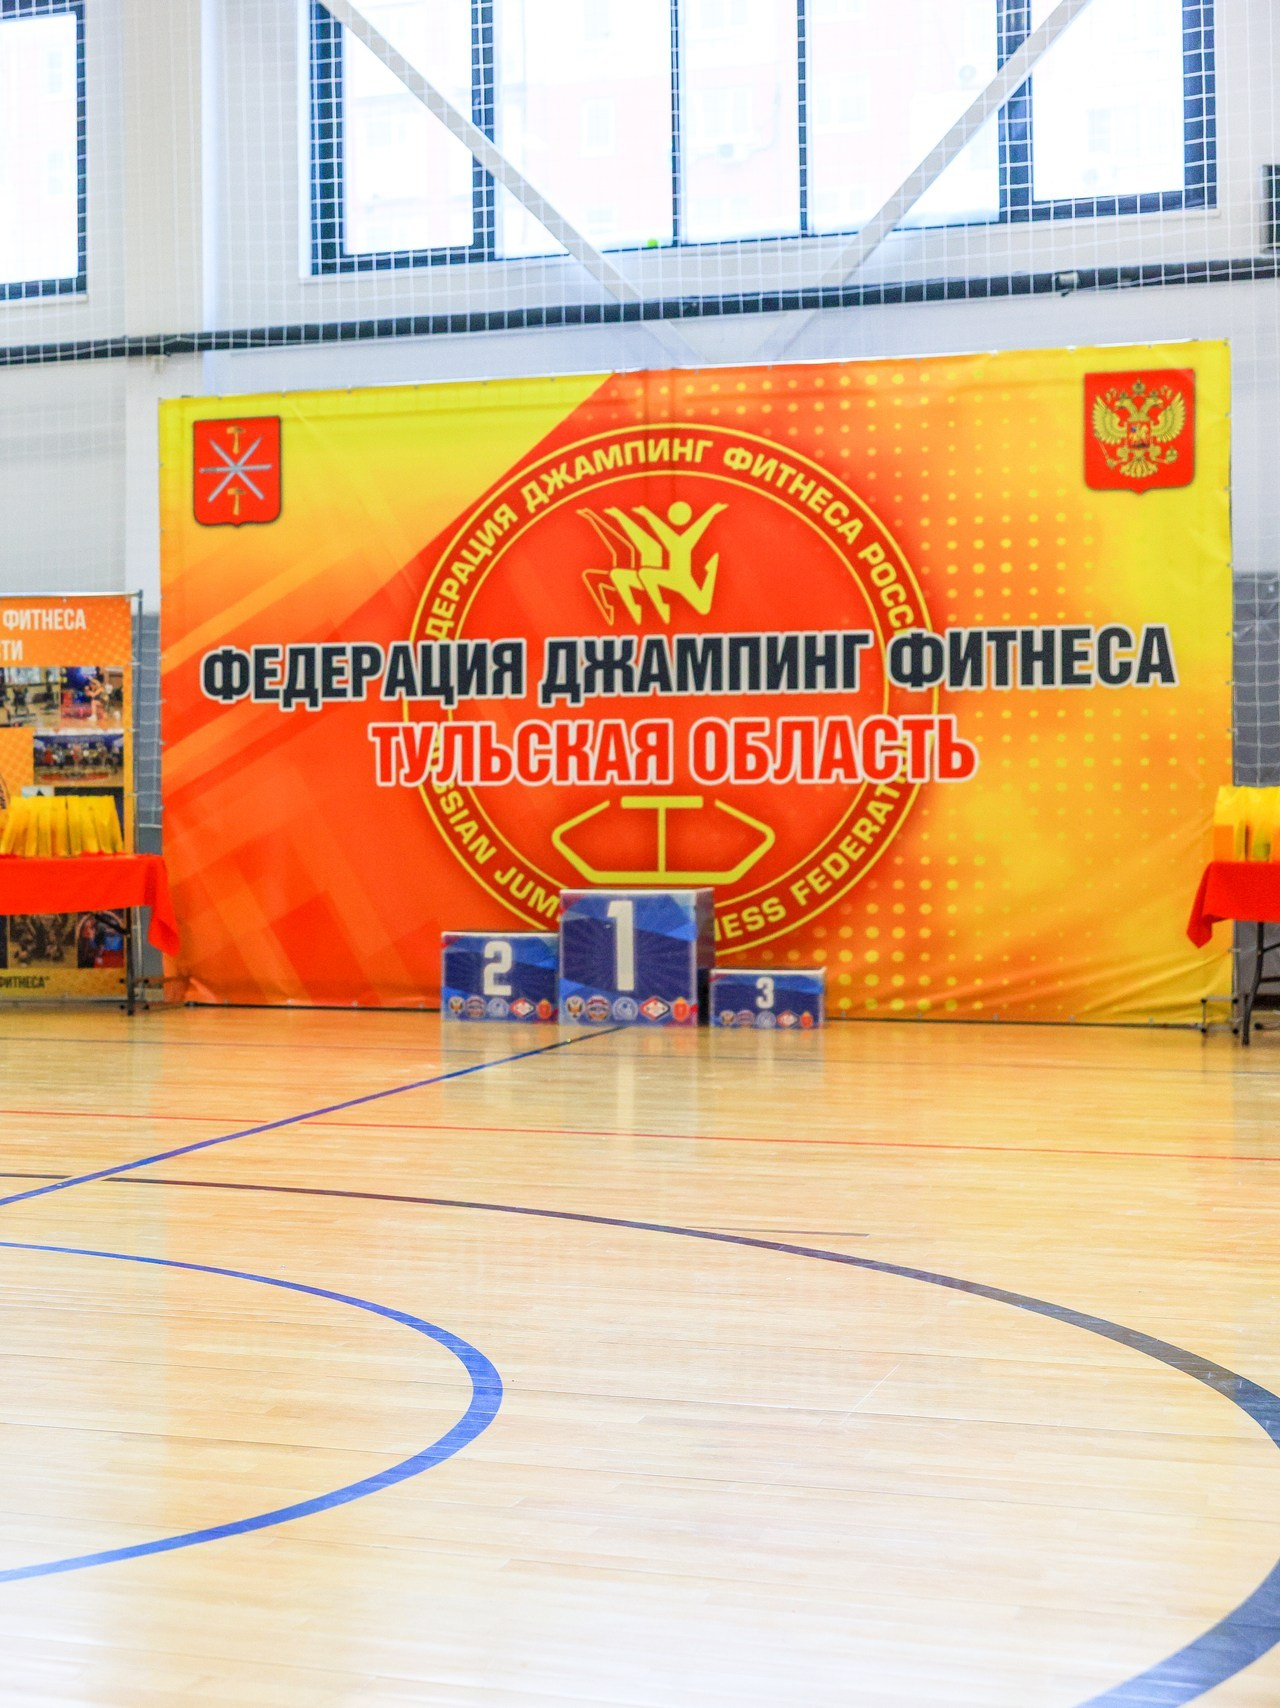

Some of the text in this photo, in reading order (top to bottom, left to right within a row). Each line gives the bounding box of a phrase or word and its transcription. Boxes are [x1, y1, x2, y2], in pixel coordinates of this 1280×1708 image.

[426, 437, 917, 641] ДЕРАЦИЯ ДЖАМПИНГ ФИТНЕСА РОСС
[2, 607, 87, 631] ФИТНЕСА
[201, 622, 1180, 710] ФЕДЕРАЦИЯ ДЖАМПИНГ ФИТНЕСА
[369, 714, 980, 788] ТУЛЬСКАЯ ОБЛАСТЬ
[432, 762, 497, 865] SIAN
[493, 866, 561, 921] JUM
[789, 765, 907, 907] FEDERAT
[482, 940, 513, 997] 2
[606, 900, 635, 992] 1
[755, 977, 775, 1009] 3
